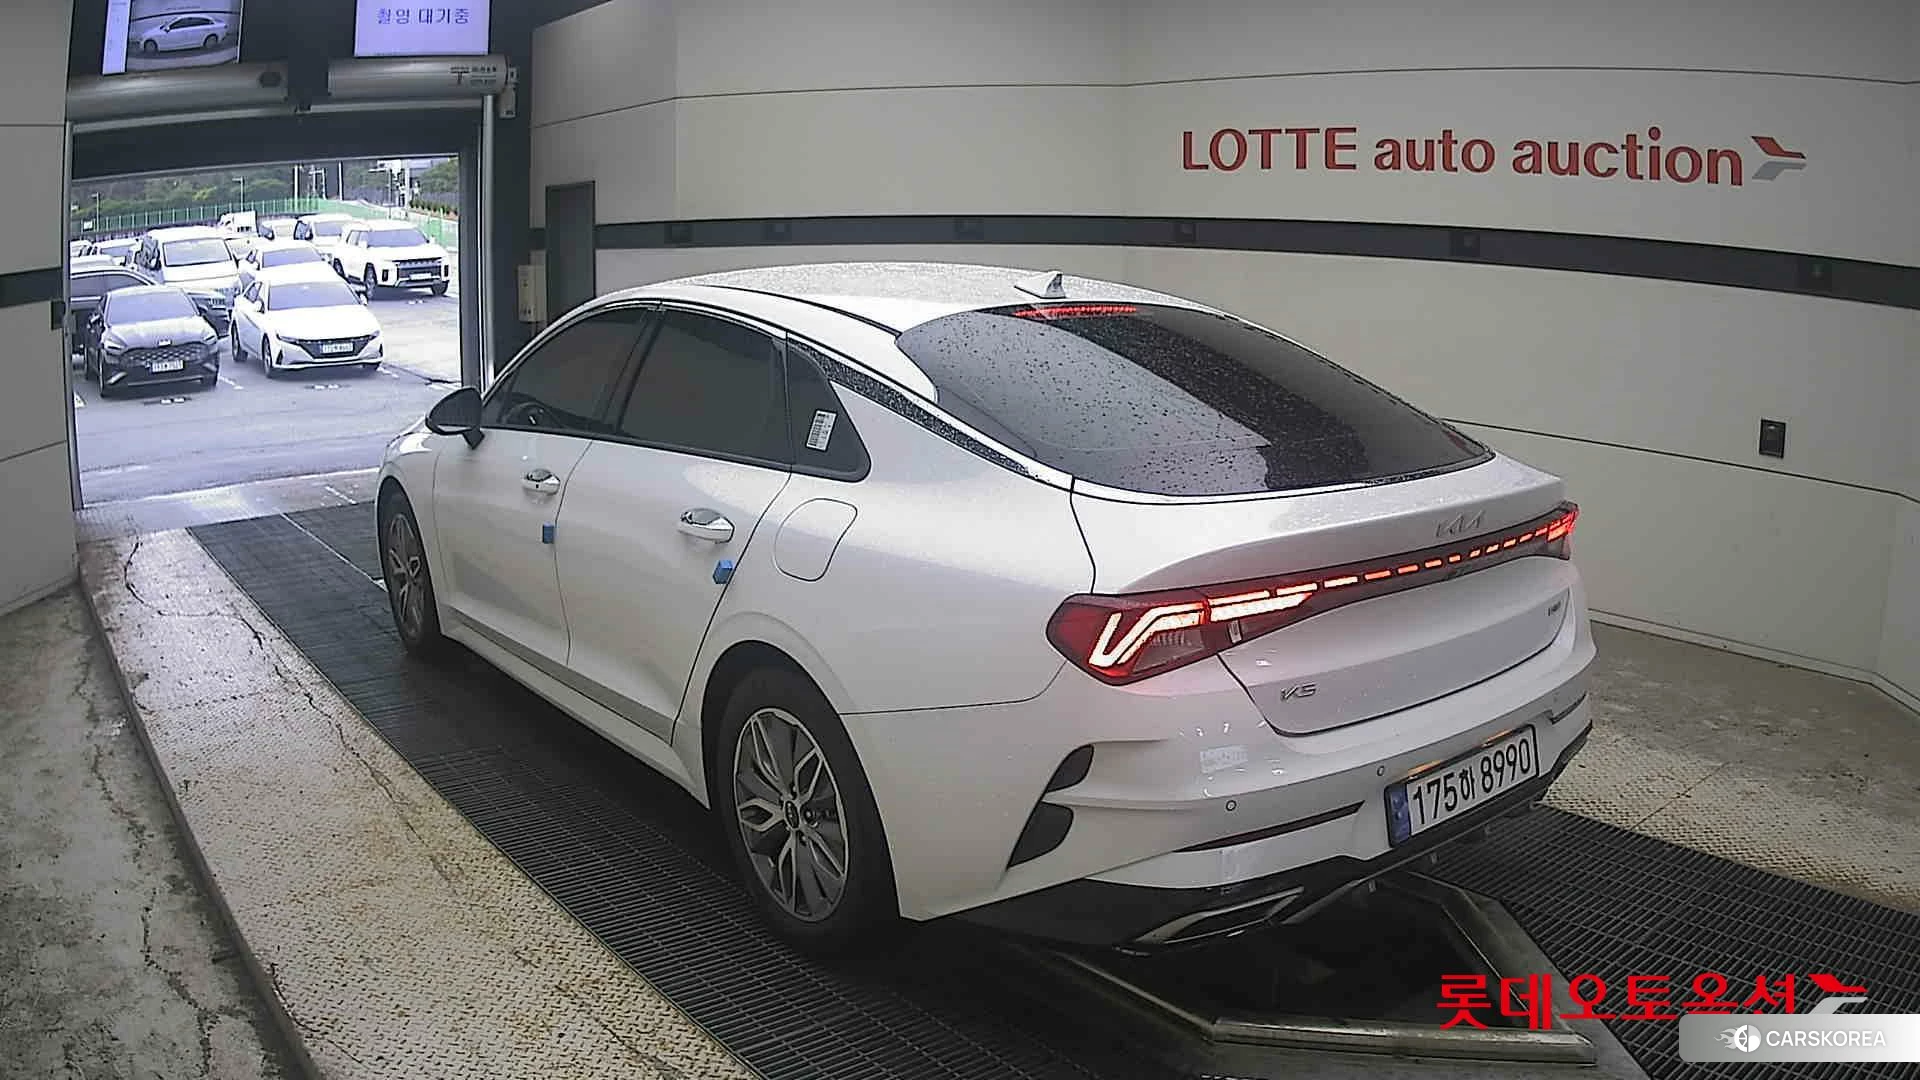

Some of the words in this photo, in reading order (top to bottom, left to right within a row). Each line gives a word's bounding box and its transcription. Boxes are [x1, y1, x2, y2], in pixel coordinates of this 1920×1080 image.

[418, 8, 470, 25] 대기중
[1182, 127, 1358, 171] LOTTE
[1373, 129, 1496, 174] auto
[1511, 126, 1744, 187] auction
[1412, 765, 1476, 825] 175하
[1479, 738, 1532, 794] 8990
